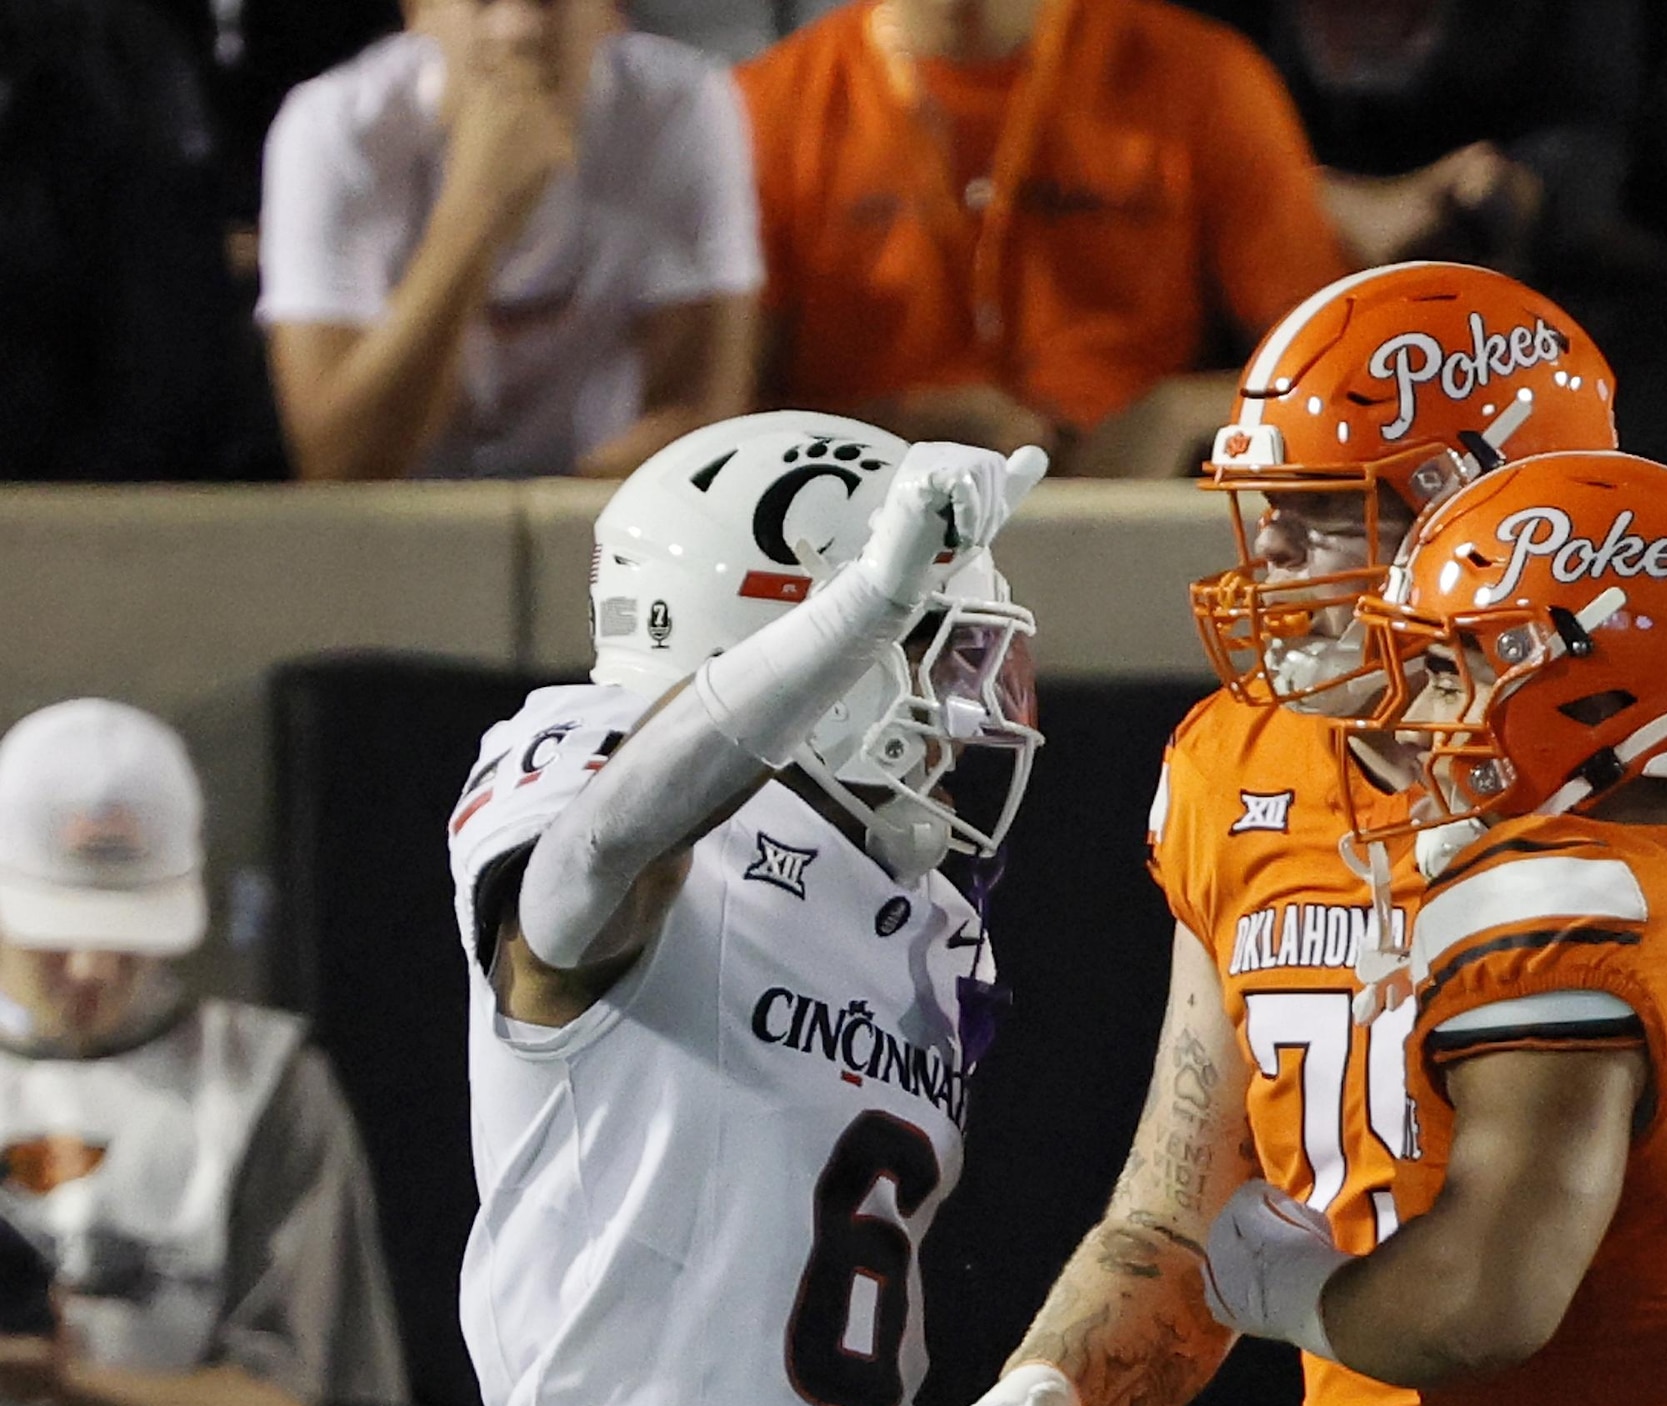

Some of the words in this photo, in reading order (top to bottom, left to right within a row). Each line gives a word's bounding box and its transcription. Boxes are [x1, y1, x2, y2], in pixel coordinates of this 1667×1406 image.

[1368, 312, 1564, 441] Pokes
[1234, 793, 1291, 832] XII
[752, 987, 957, 1119] CINCINNA
